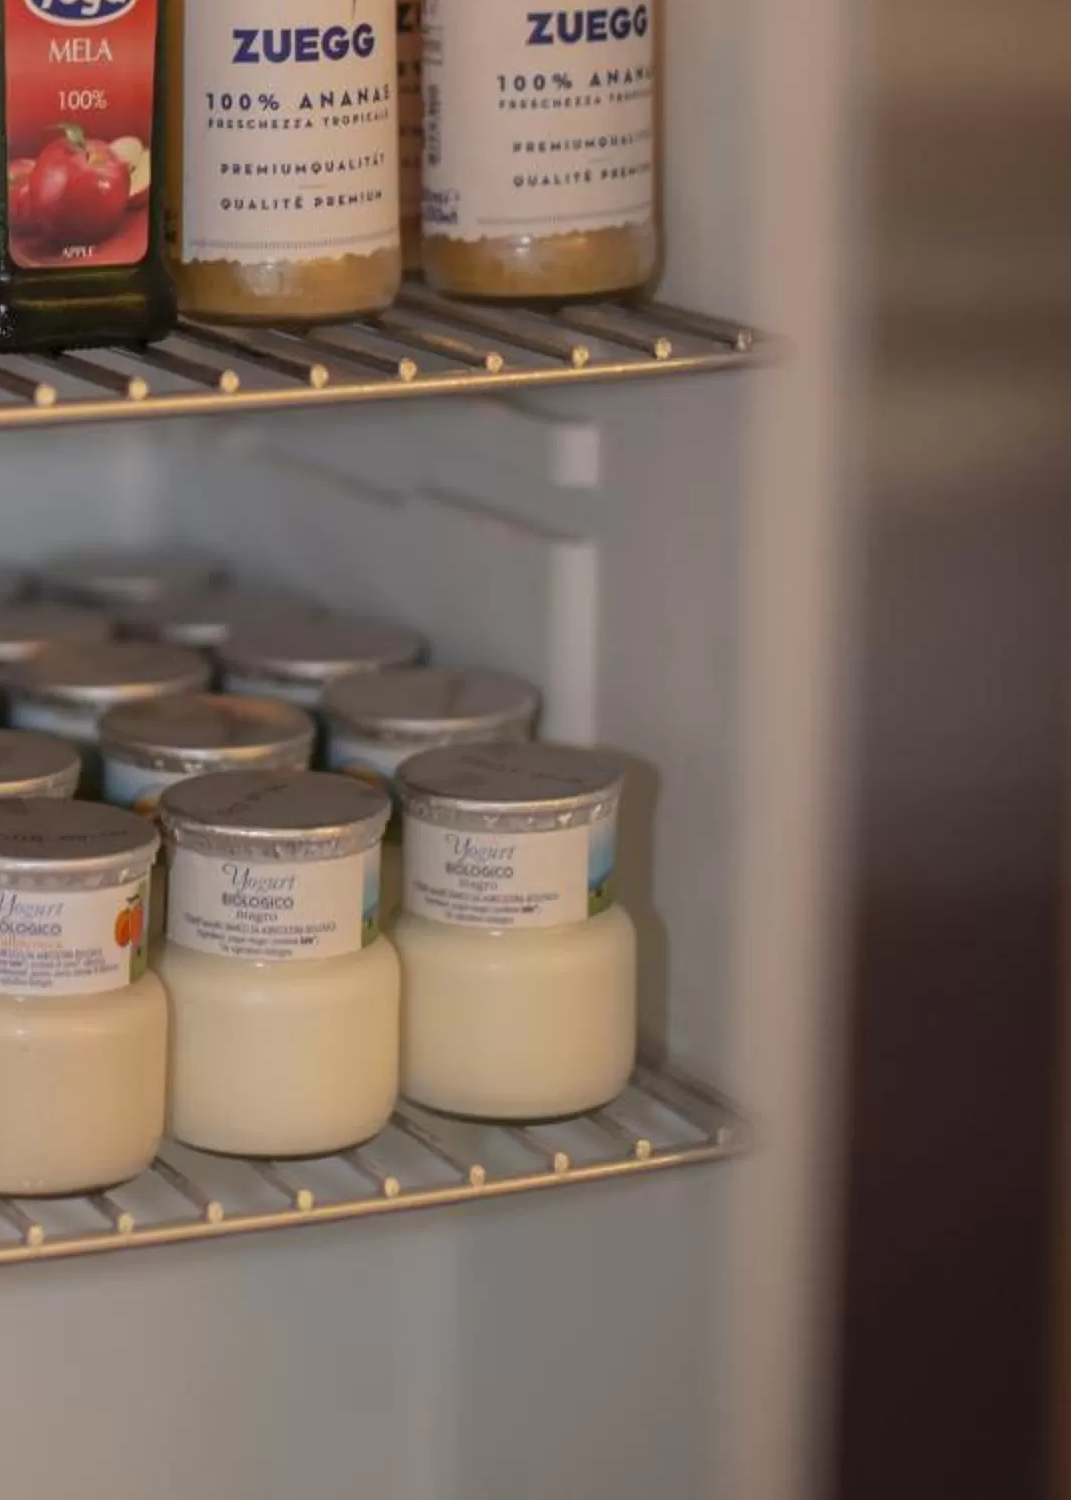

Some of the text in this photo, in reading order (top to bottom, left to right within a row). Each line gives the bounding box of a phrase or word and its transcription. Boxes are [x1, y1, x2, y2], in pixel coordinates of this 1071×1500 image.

[525, 3, 649, 46] ZUEGG
[48, 37, 113, 64] MELA
[232, 22, 375, 64] ZUEGG
[496, 72, 573, 92] 100%
[58, 90, 108, 111] 100%
[205, 92, 280, 111] 100%
[208, 117, 314, 130] FRESCHEZZA
[220, 189, 382, 211] QUALITÉ PREMIUM
[62, 246, 96, 259] APPLE
[445, 834, 516, 864] Yogurt
[221, 863, 296, 894] Yogurt
